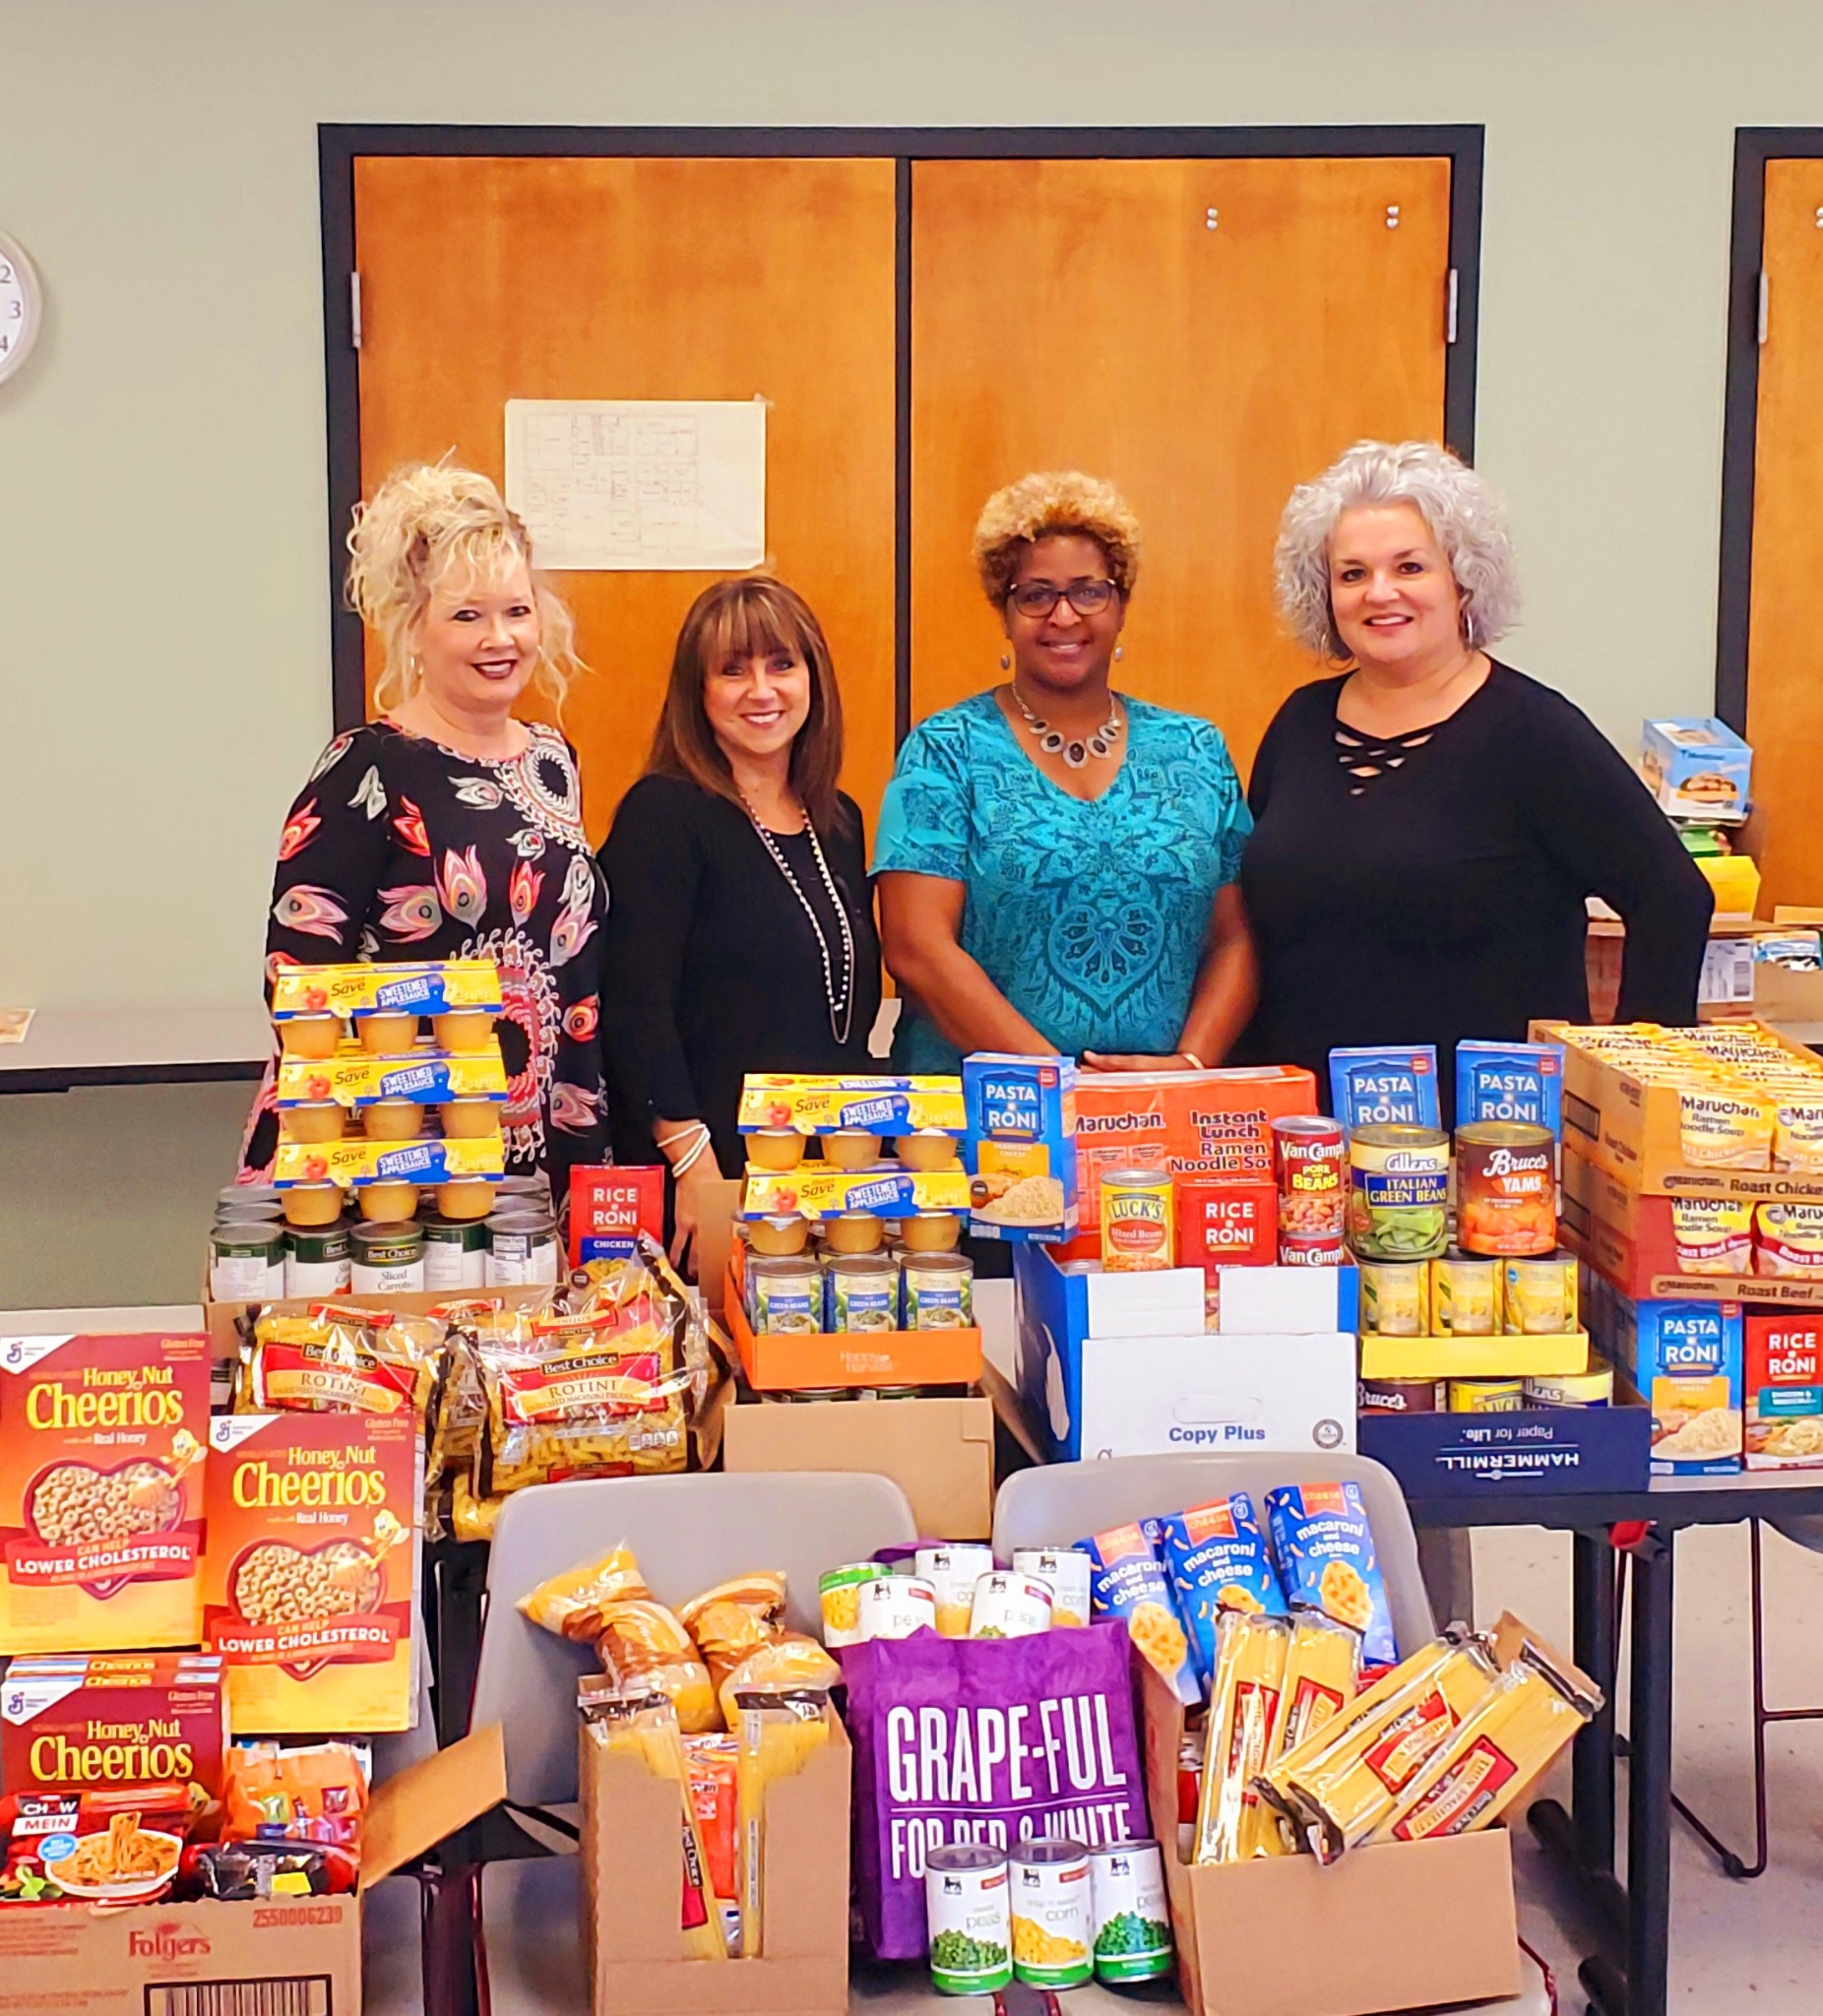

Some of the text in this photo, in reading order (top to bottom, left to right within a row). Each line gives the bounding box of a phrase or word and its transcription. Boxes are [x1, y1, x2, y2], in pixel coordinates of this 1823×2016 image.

[9, 300, 21, 319] 3
[332, 981, 365, 996] Save
[379, 978, 427, 1000] SWEETENED
[381, 989, 429, 1007] APPLESAUCE
[335, 1069, 369, 1085] Save
[383, 1067, 432, 1088] SWEETENED
[1354, 1076, 1413, 1093] PASTA
[1479, 1074, 1538, 1092] PASTA
[385, 1077, 434, 1096] APPLESAUCE
[985, 1084, 1037, 1102] PASTA
[794, 1098, 830, 1112] Save
[843, 1099, 892, 1119] SWEETENED
[1358, 1104, 1414, 1123] RONI
[1481, 1102, 1537, 1120] RONI
[1681, 1096, 1760, 1118] Maruchan
[845, 1108, 894, 1125] APPLESAUCE
[988, 1110, 1037, 1129] RONI
[1191, 1109, 1267, 1125] Instant
[1692, 1113, 1730, 1124] Ramen
[1200, 1125, 1260, 1139] Lunch
[1717, 1124, 1744, 1137] Soup
[379, 1147, 429, 1167] SWEETENED
[1201, 1142, 1266, 1156] Ramen
[332, 1150, 366, 1166] Save
[382, 1157, 431, 1176] APPLESAUCE
[1170, 1157, 1238, 1171] Noodle
[1482, 1149, 1548, 1177] Bruce's
[1302, 1165, 1331, 1174] PORK
[1292, 1171, 1338, 1191] BEANS
[1386, 1178, 1437, 1190] ITALIAN
[1502, 1175, 1541, 1193] YAMS
[1730, 1179, 1771, 1193] Roast
[1775, 1181, 1823, 1195] Chicke
[593, 1187, 638, 1202] RICE
[800, 1184, 835, 1198] Save
[848, 1181, 896, 1201] SWEETENED
[849, 1190, 899, 1209] APPLESAUCE
[1370, 1189, 1447, 1203] GREEN BEANS
[593, 1211, 637, 1226] RONI
[1110, 1200, 1163, 1220] LUCK'S
[1205, 1203, 1254, 1219] RICE
[1681, 1214, 1718, 1223] Ramen
[1111, 1228, 1137, 1238] Mixed
[1205, 1228, 1254, 1244] RONI
[326, 1243, 343, 1255] Best
[367, 1246, 417, 1259] Best Choice
[1779, 1245, 1811, 1264] Roast
[381, 1270, 407, 1280] Sliced
[1737, 1285, 1777, 1297] Roast
[1781, 1286, 1814, 1298] Beef
[1664, 1319, 1719, 1335] PASTA
[1769, 1333, 1817, 1350] RICE
[331, 1350, 376, 1368] Coice
[1666, 1345, 1718, 1362] RONI
[544, 1354, 618, 1375] Best Choice
[1769, 1357, 1816, 1374] RONI
[84, 1367, 138, 1389] Honey
[142, 1366, 173, 1384] Nut
[300, 1372, 367, 1397] ROTINI
[548, 1378, 617, 1399] ROTINI
[1526, 1378, 1561, 1401] llens
[27, 1382, 184, 1429] Cheerios
[94, 1433, 114, 1445] Real
[117, 1432, 148, 1446] Honey
[1168, 1425, 1266, 1443] Copy Plus
[1495, 1428, 1513, 1441] for
[1516, 1425, 1553, 1439] Paper
[288, 1446, 376, 1470] Honey Nut
[1440, 1453, 1580, 1471] HAMMERMILL
[233, 1461, 386, 1508] Cheerios
[1303, 1490, 1341, 1501] cheese
[296, 1512, 316, 1524] Real
[319, 1512, 348, 1526] Honey
[1188, 1514, 1229, 1529] cheese
[1296, 1521, 1364, 1542] macaroni
[1100, 1532, 1139, 1550] cheese
[1308, 1542, 1360, 1557] cheese
[77, 1544, 99, 1556] CAN
[1183, 1543, 1256, 1572] macaroni
[15, 1558, 75, 1574] LOWER
[78, 1545, 191, 1570] CHOLESTEROL
[1212, 1557, 1230, 1567] and
[1097, 1560, 1166, 1593] macaroni
[1125, 1574, 1144, 1586] and
[1198, 1564, 1253, 1587] cheese
[1112, 1581, 1165, 1606] cheese
[278, 1625, 298, 1635] CAN
[219, 1638, 274, 1653] LOWER
[278, 1627, 390, 1650] CHOLESTEROL
[90, 1660, 155, 1670] Cheerios
[86, 1676, 152, 1686] Cheerios
[88, 1719, 181, 1743] Honey Nut
[887, 1693, 1127, 1803] GRAPE-FUL
[31, 1735, 194, 1781] Cheerios
[25, 1818, 71, 1830] MEIN
[966, 1914, 1001, 1930] peas
[1045, 1907, 1079, 1922] corn
[129, 1930, 211, 1961] Folgers
